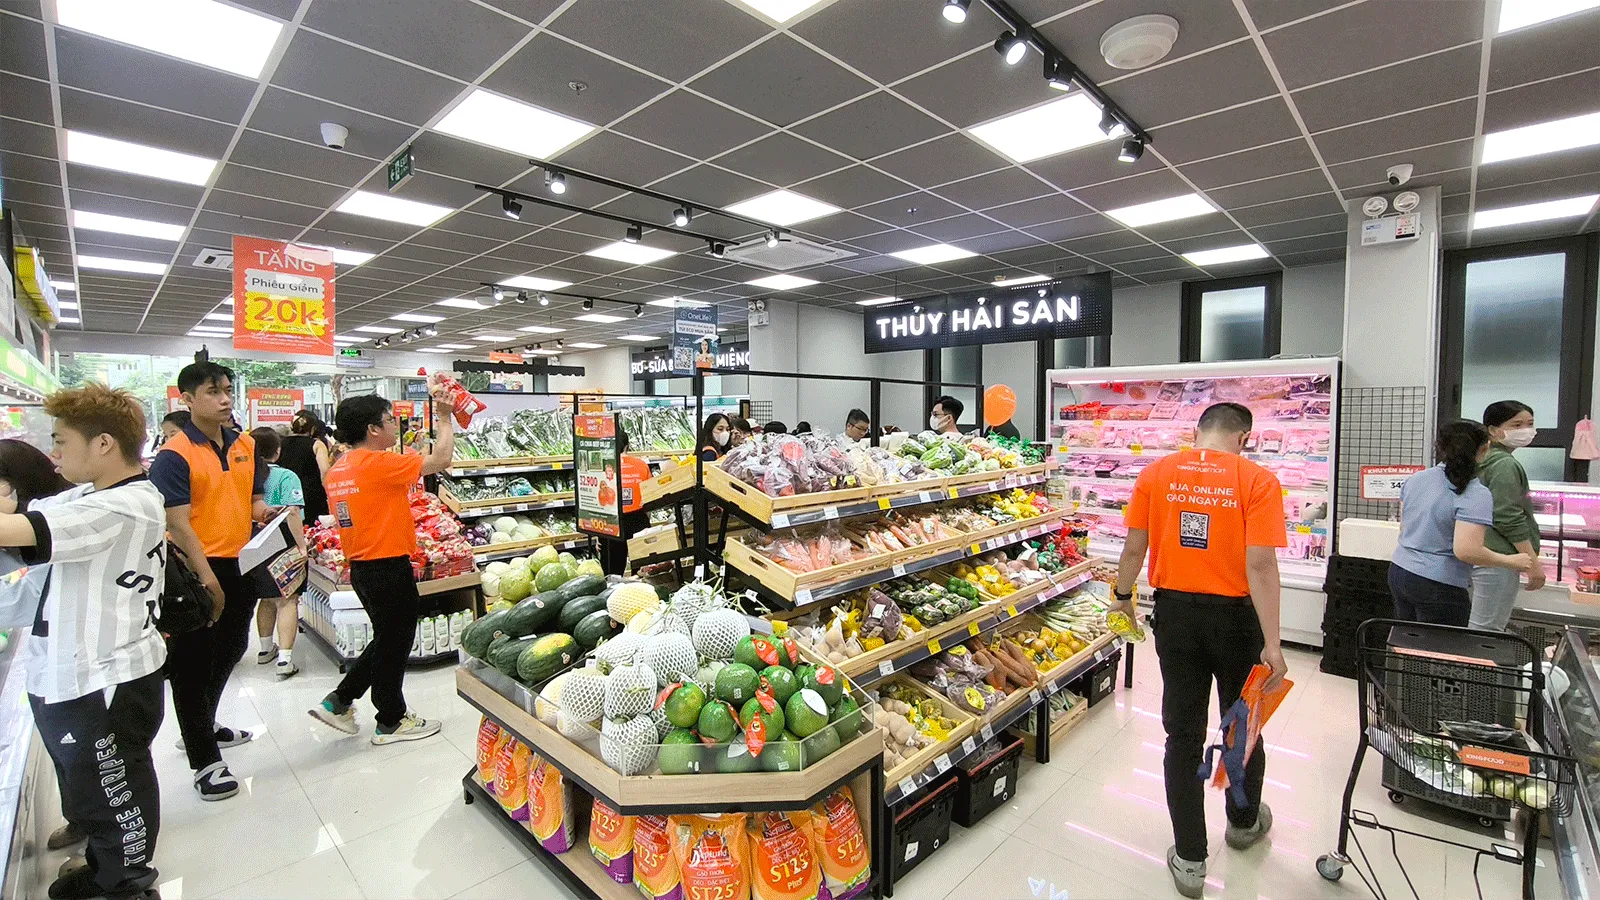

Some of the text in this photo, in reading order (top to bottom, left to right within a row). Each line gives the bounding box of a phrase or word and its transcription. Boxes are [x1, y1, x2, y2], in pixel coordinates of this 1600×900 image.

[254, 247, 316, 272] TẶNG
[254, 296, 318, 326] 20k
[876, 289, 1081, 339] THỦY HẢI SẢN
[1188, 495, 1219, 506] NGAY
[1221, 498, 1238, 509] 2H
[1193, 485, 1234, 496] ONLINE
[95, 733, 147, 867] THREE STRIPES
